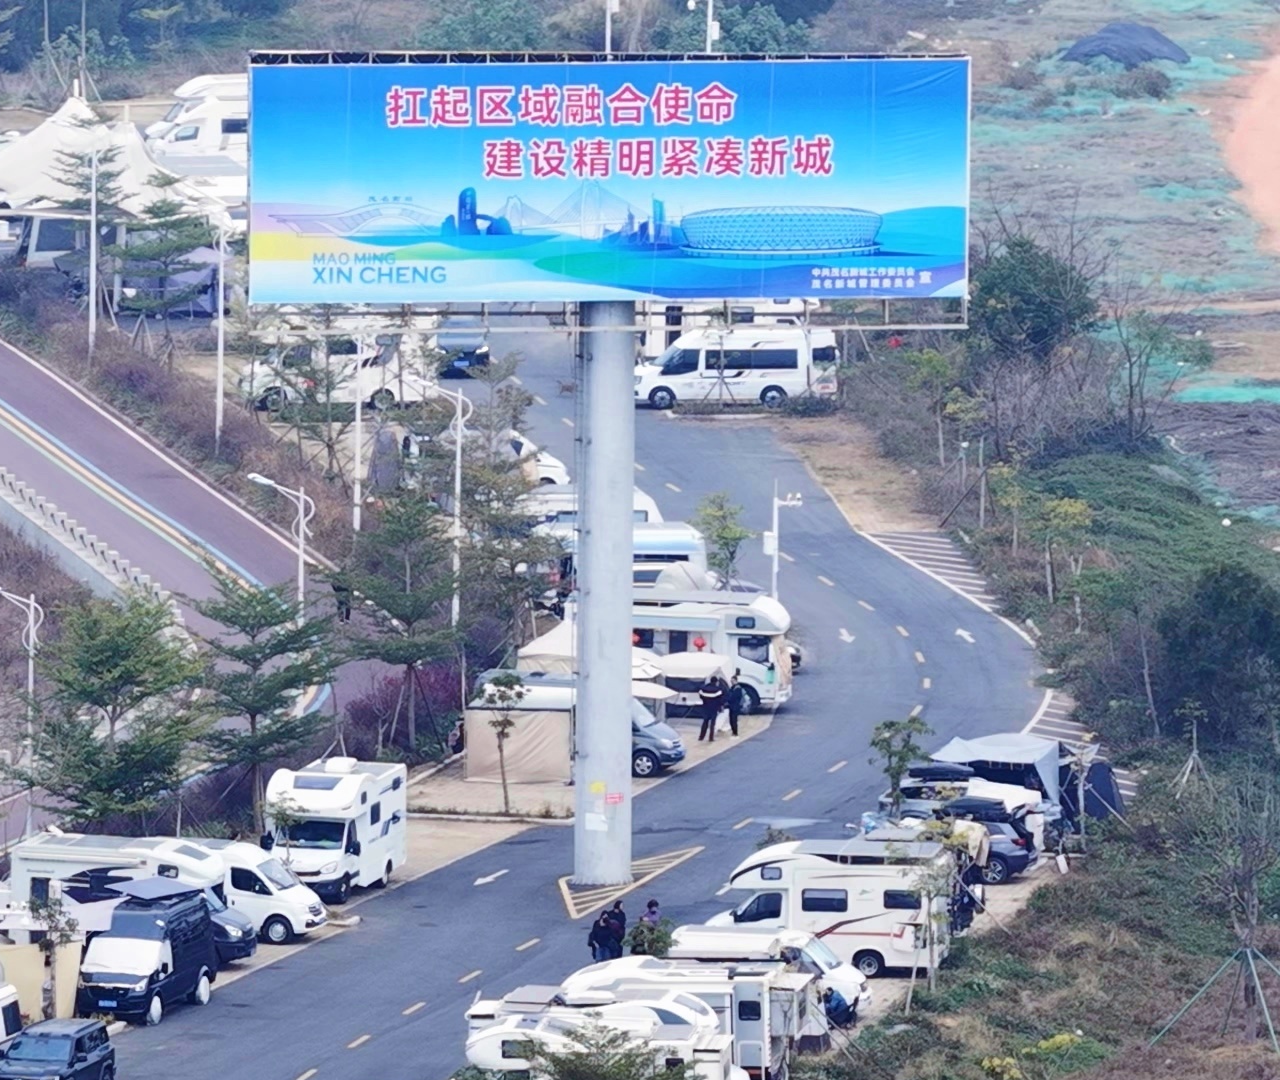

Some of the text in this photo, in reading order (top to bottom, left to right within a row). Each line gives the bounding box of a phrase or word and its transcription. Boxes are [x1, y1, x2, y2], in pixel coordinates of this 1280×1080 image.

[386, 83, 737, 127] 扛起区域融合使命
[484, 137, 833, 178] 建设精明紧凑新城
[313, 252, 396, 265] MAO MING
[313, 266, 447, 284] XIN CHENG
